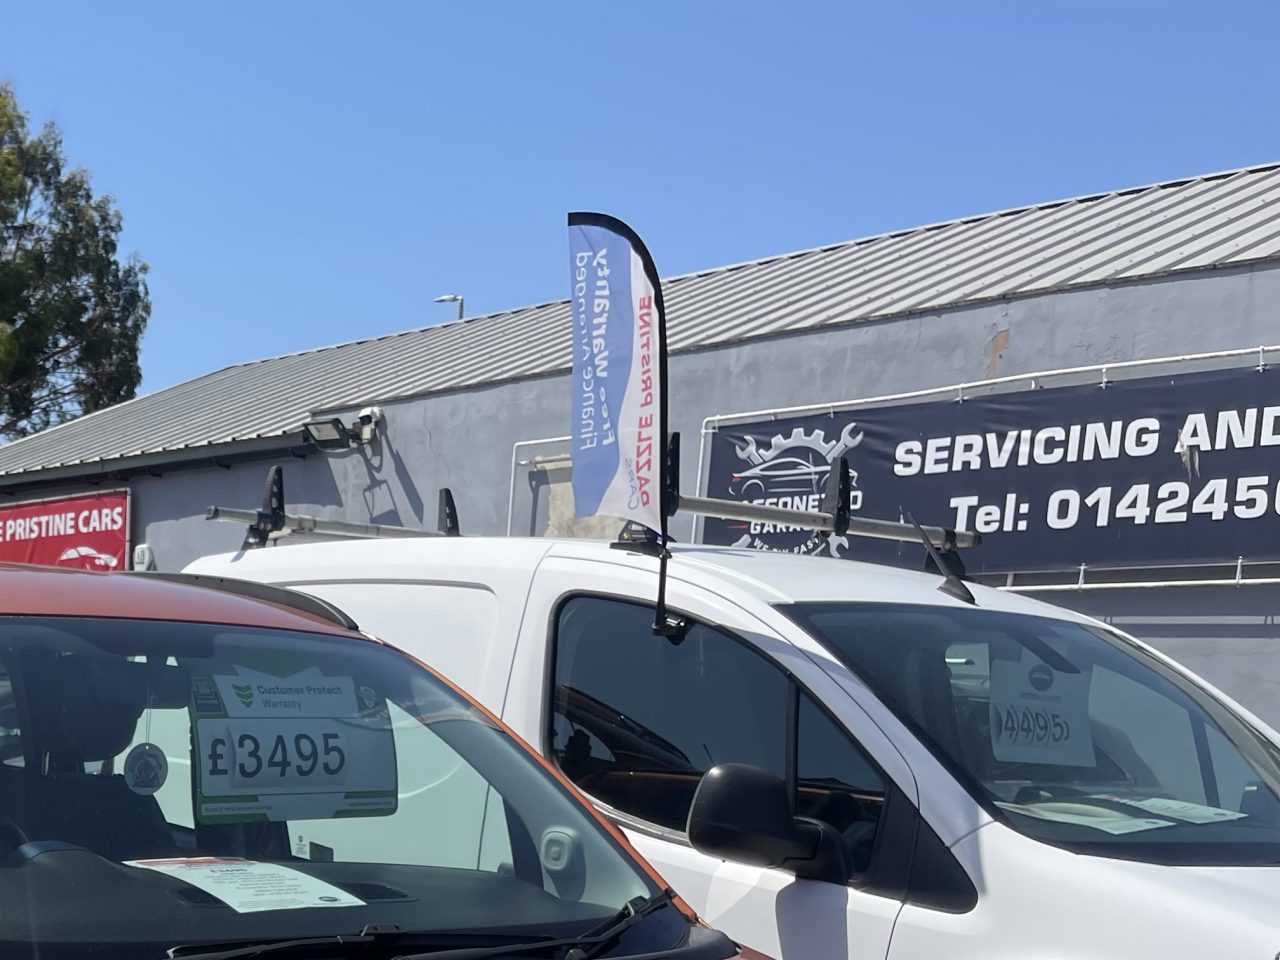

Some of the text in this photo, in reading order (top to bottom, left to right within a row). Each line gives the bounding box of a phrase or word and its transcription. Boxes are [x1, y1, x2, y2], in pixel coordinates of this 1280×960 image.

[893, 417, 1161, 477] SERVICING
[5, 512, 75, 543] PRISTINE
[78, 507, 123, 533] CARS
[949, 475, 1280, 534] Tel: 014245
[256, 684, 343, 696] Customer Protect
[262, 698, 302, 711] Warranty
[208, 732, 345, 779] £3495
